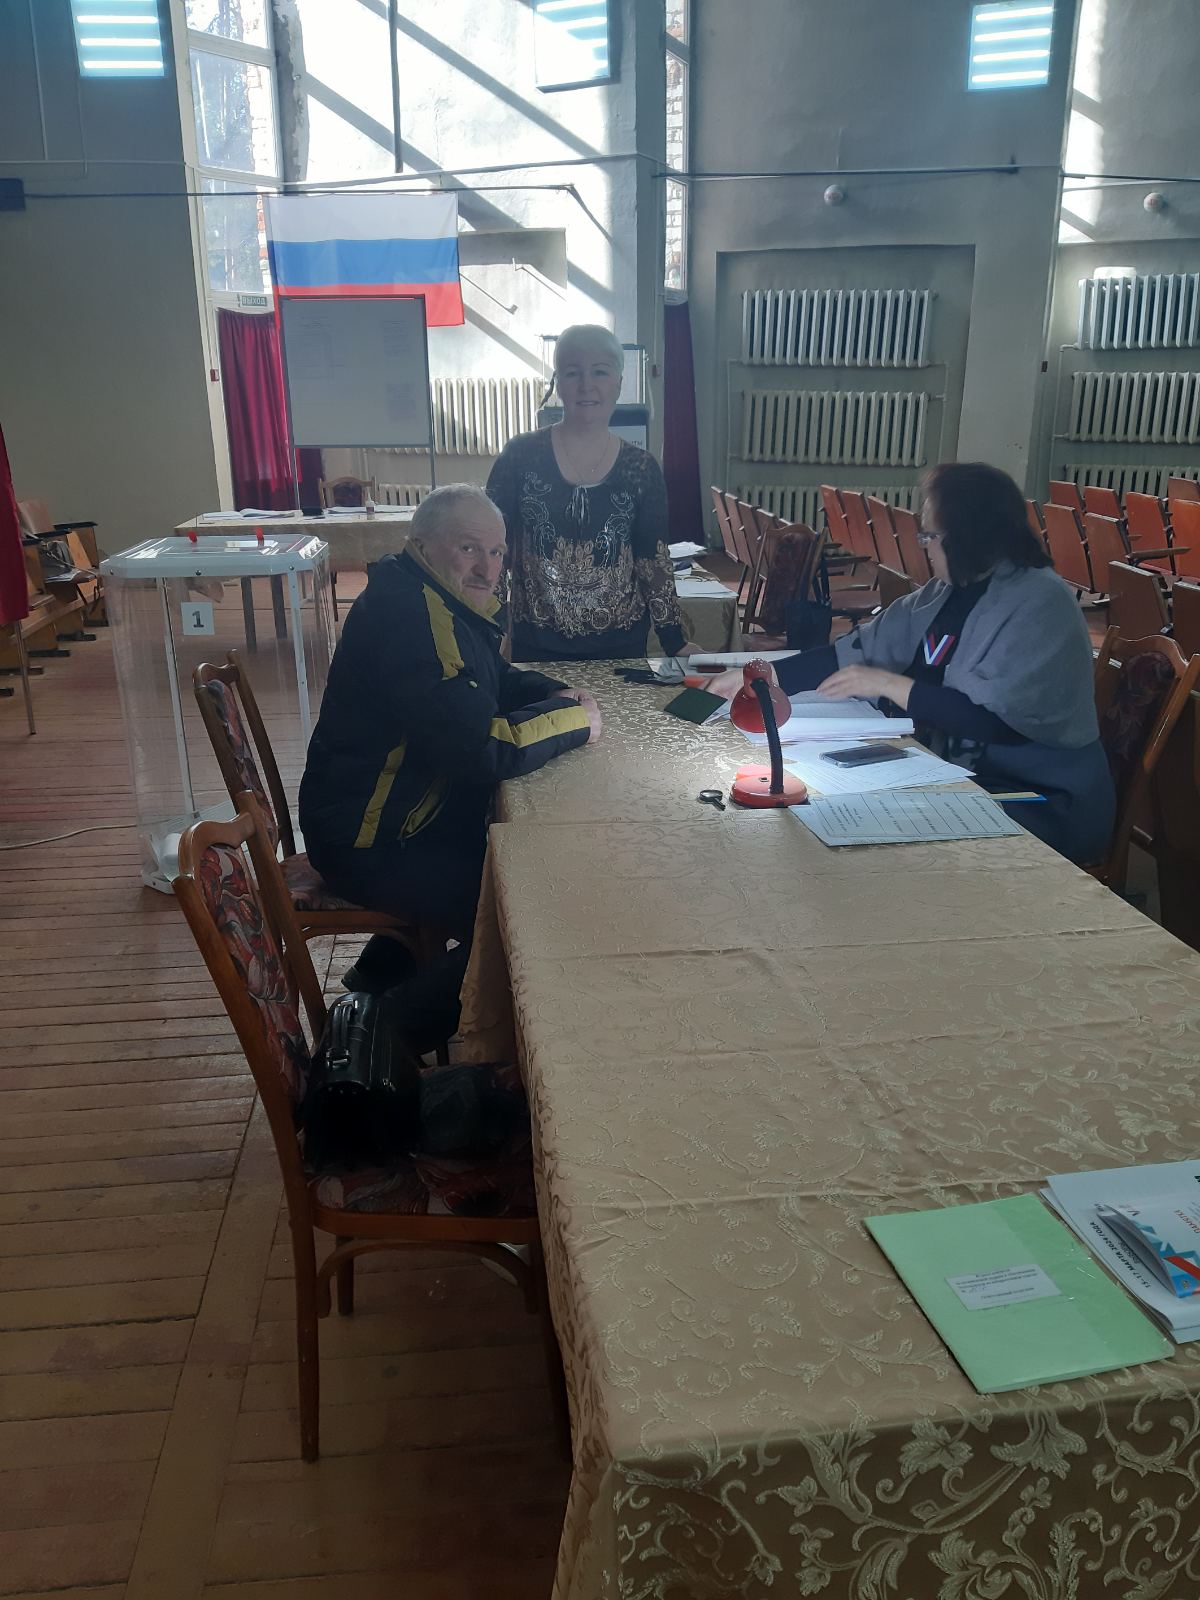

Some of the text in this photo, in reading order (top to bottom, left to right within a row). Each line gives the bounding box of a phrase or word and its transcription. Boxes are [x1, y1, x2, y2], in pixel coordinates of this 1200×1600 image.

[242, 296, 266, 305] ВЫХОД
[192, 610, 204, 628] 1
[1090, 1222, 1106, 1237] ГОДА
[1103, 1238, 1117, 1250] 2024
[1116, 1251, 1135, 1270] МАРТА
